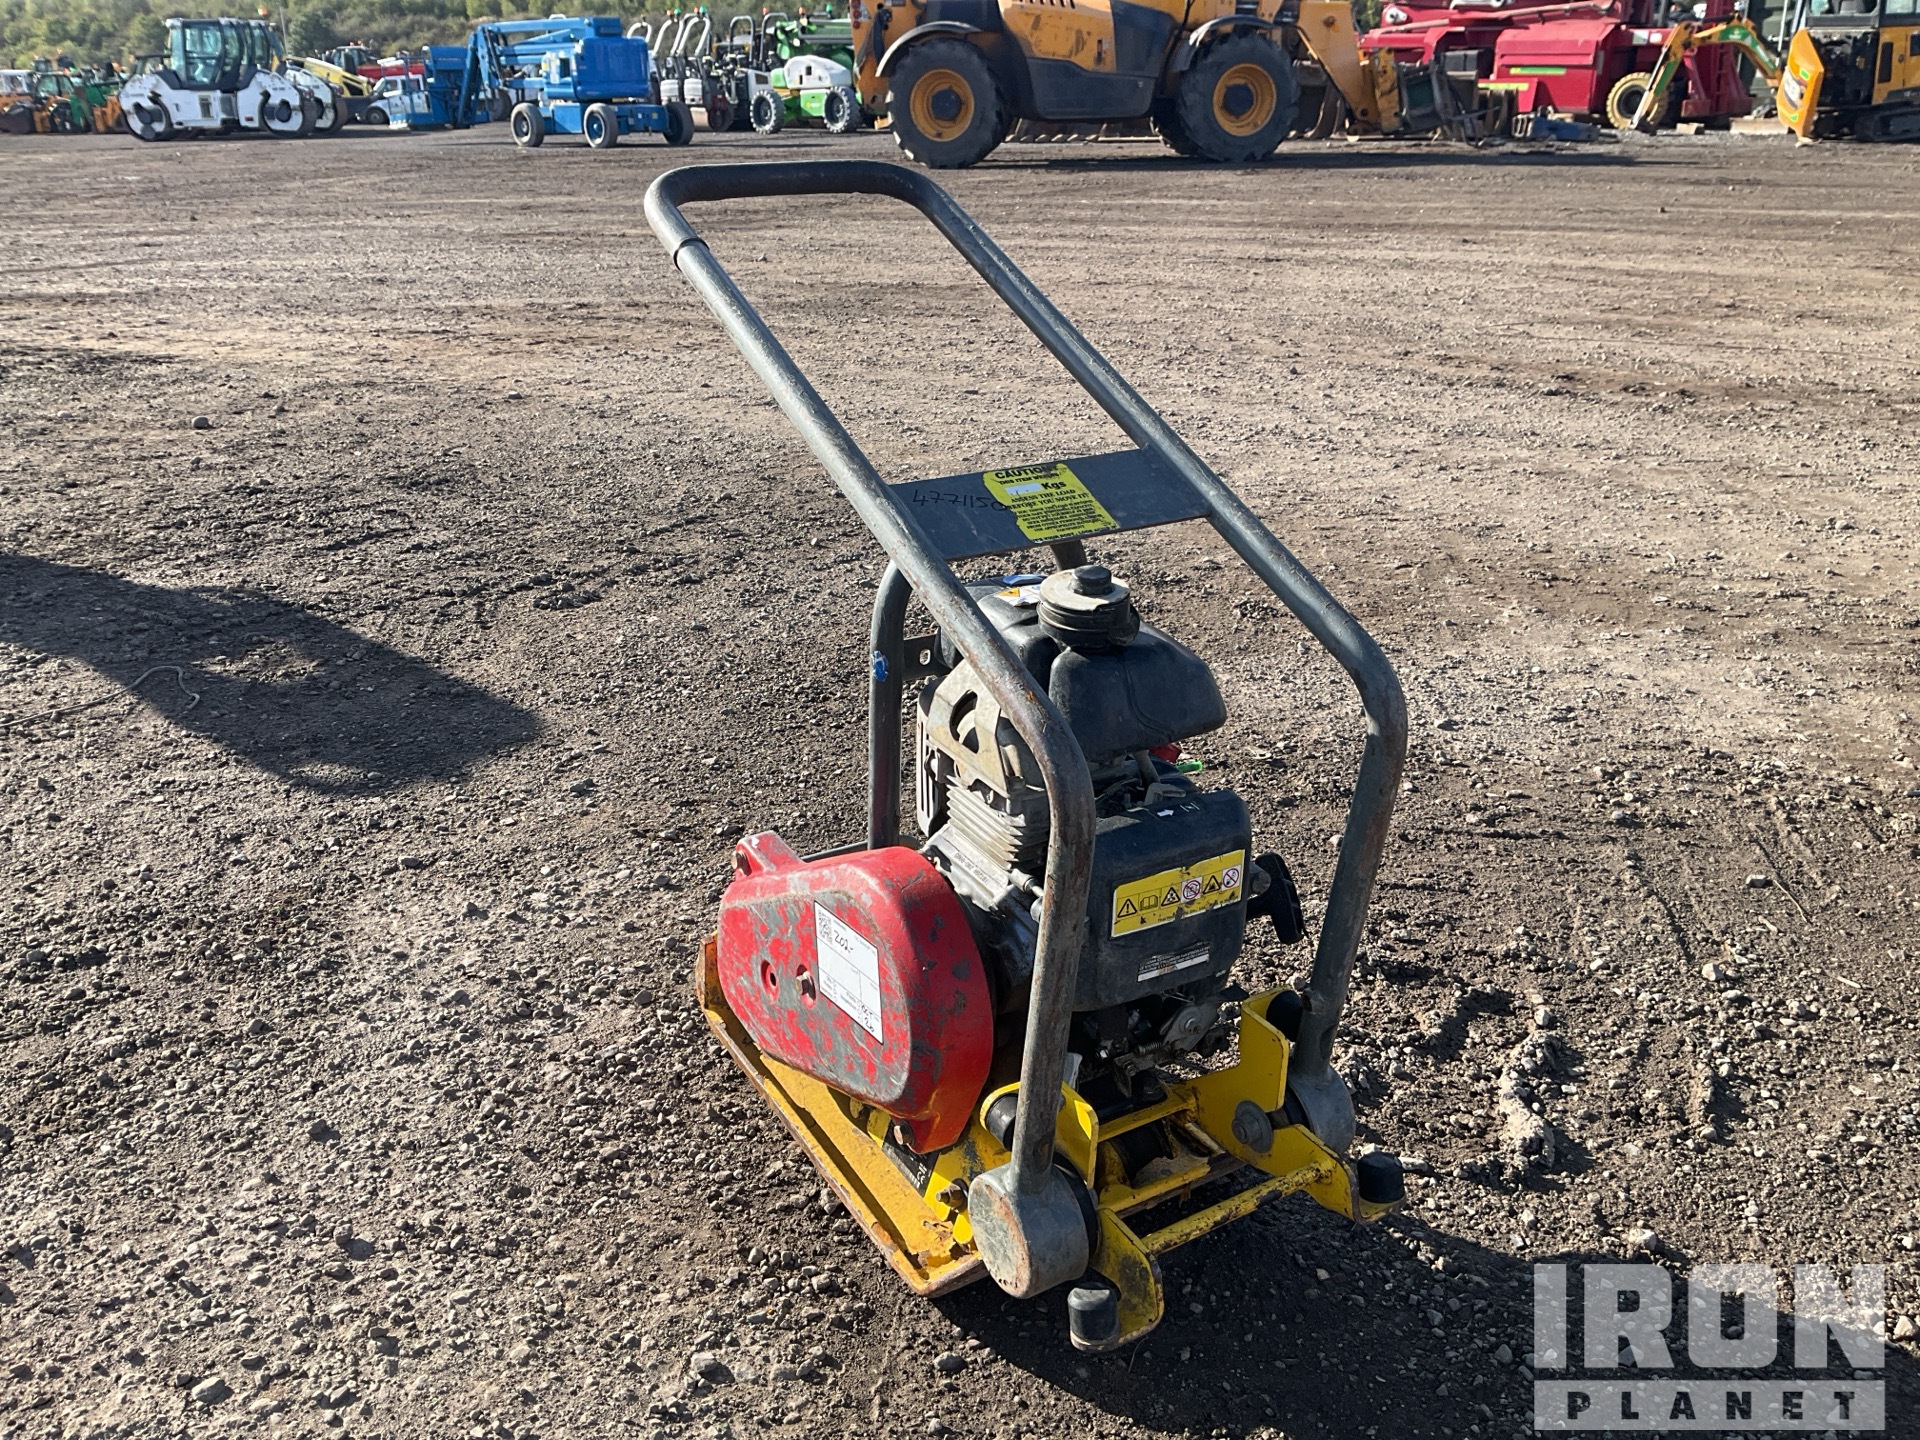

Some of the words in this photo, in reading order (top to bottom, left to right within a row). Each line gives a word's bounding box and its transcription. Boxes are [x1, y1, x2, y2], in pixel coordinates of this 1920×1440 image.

[1041, 481, 1067, 490] Kgs
[1056, 489, 1076, 497] LOAD
[1036, 498, 1054, 506] YOU
